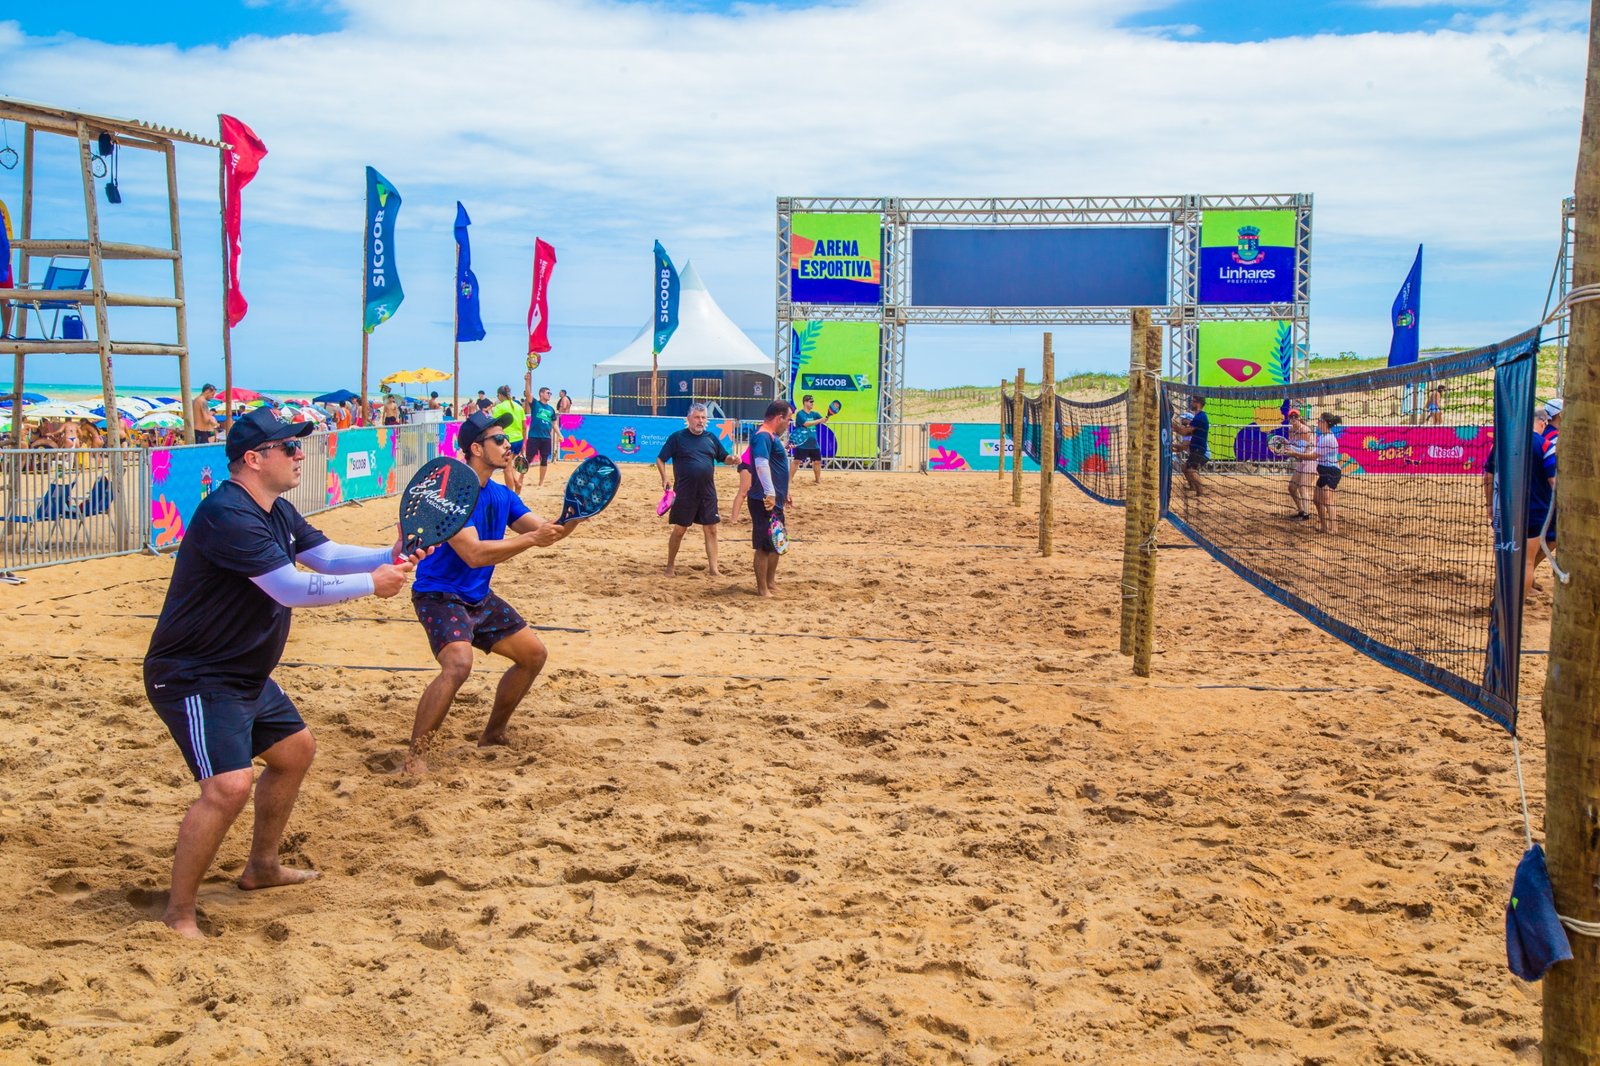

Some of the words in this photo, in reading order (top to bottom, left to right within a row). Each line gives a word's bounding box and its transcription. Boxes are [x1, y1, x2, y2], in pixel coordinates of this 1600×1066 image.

[373, 210, 385, 287] SICOOB
[813, 239, 859, 256] ARENA
[800, 260, 872, 278] ESPORTIVA
[1219, 266, 1276, 279] Linhares
[660, 268, 671, 323] SICOOB
[815, 378, 847, 387] SICOOB
